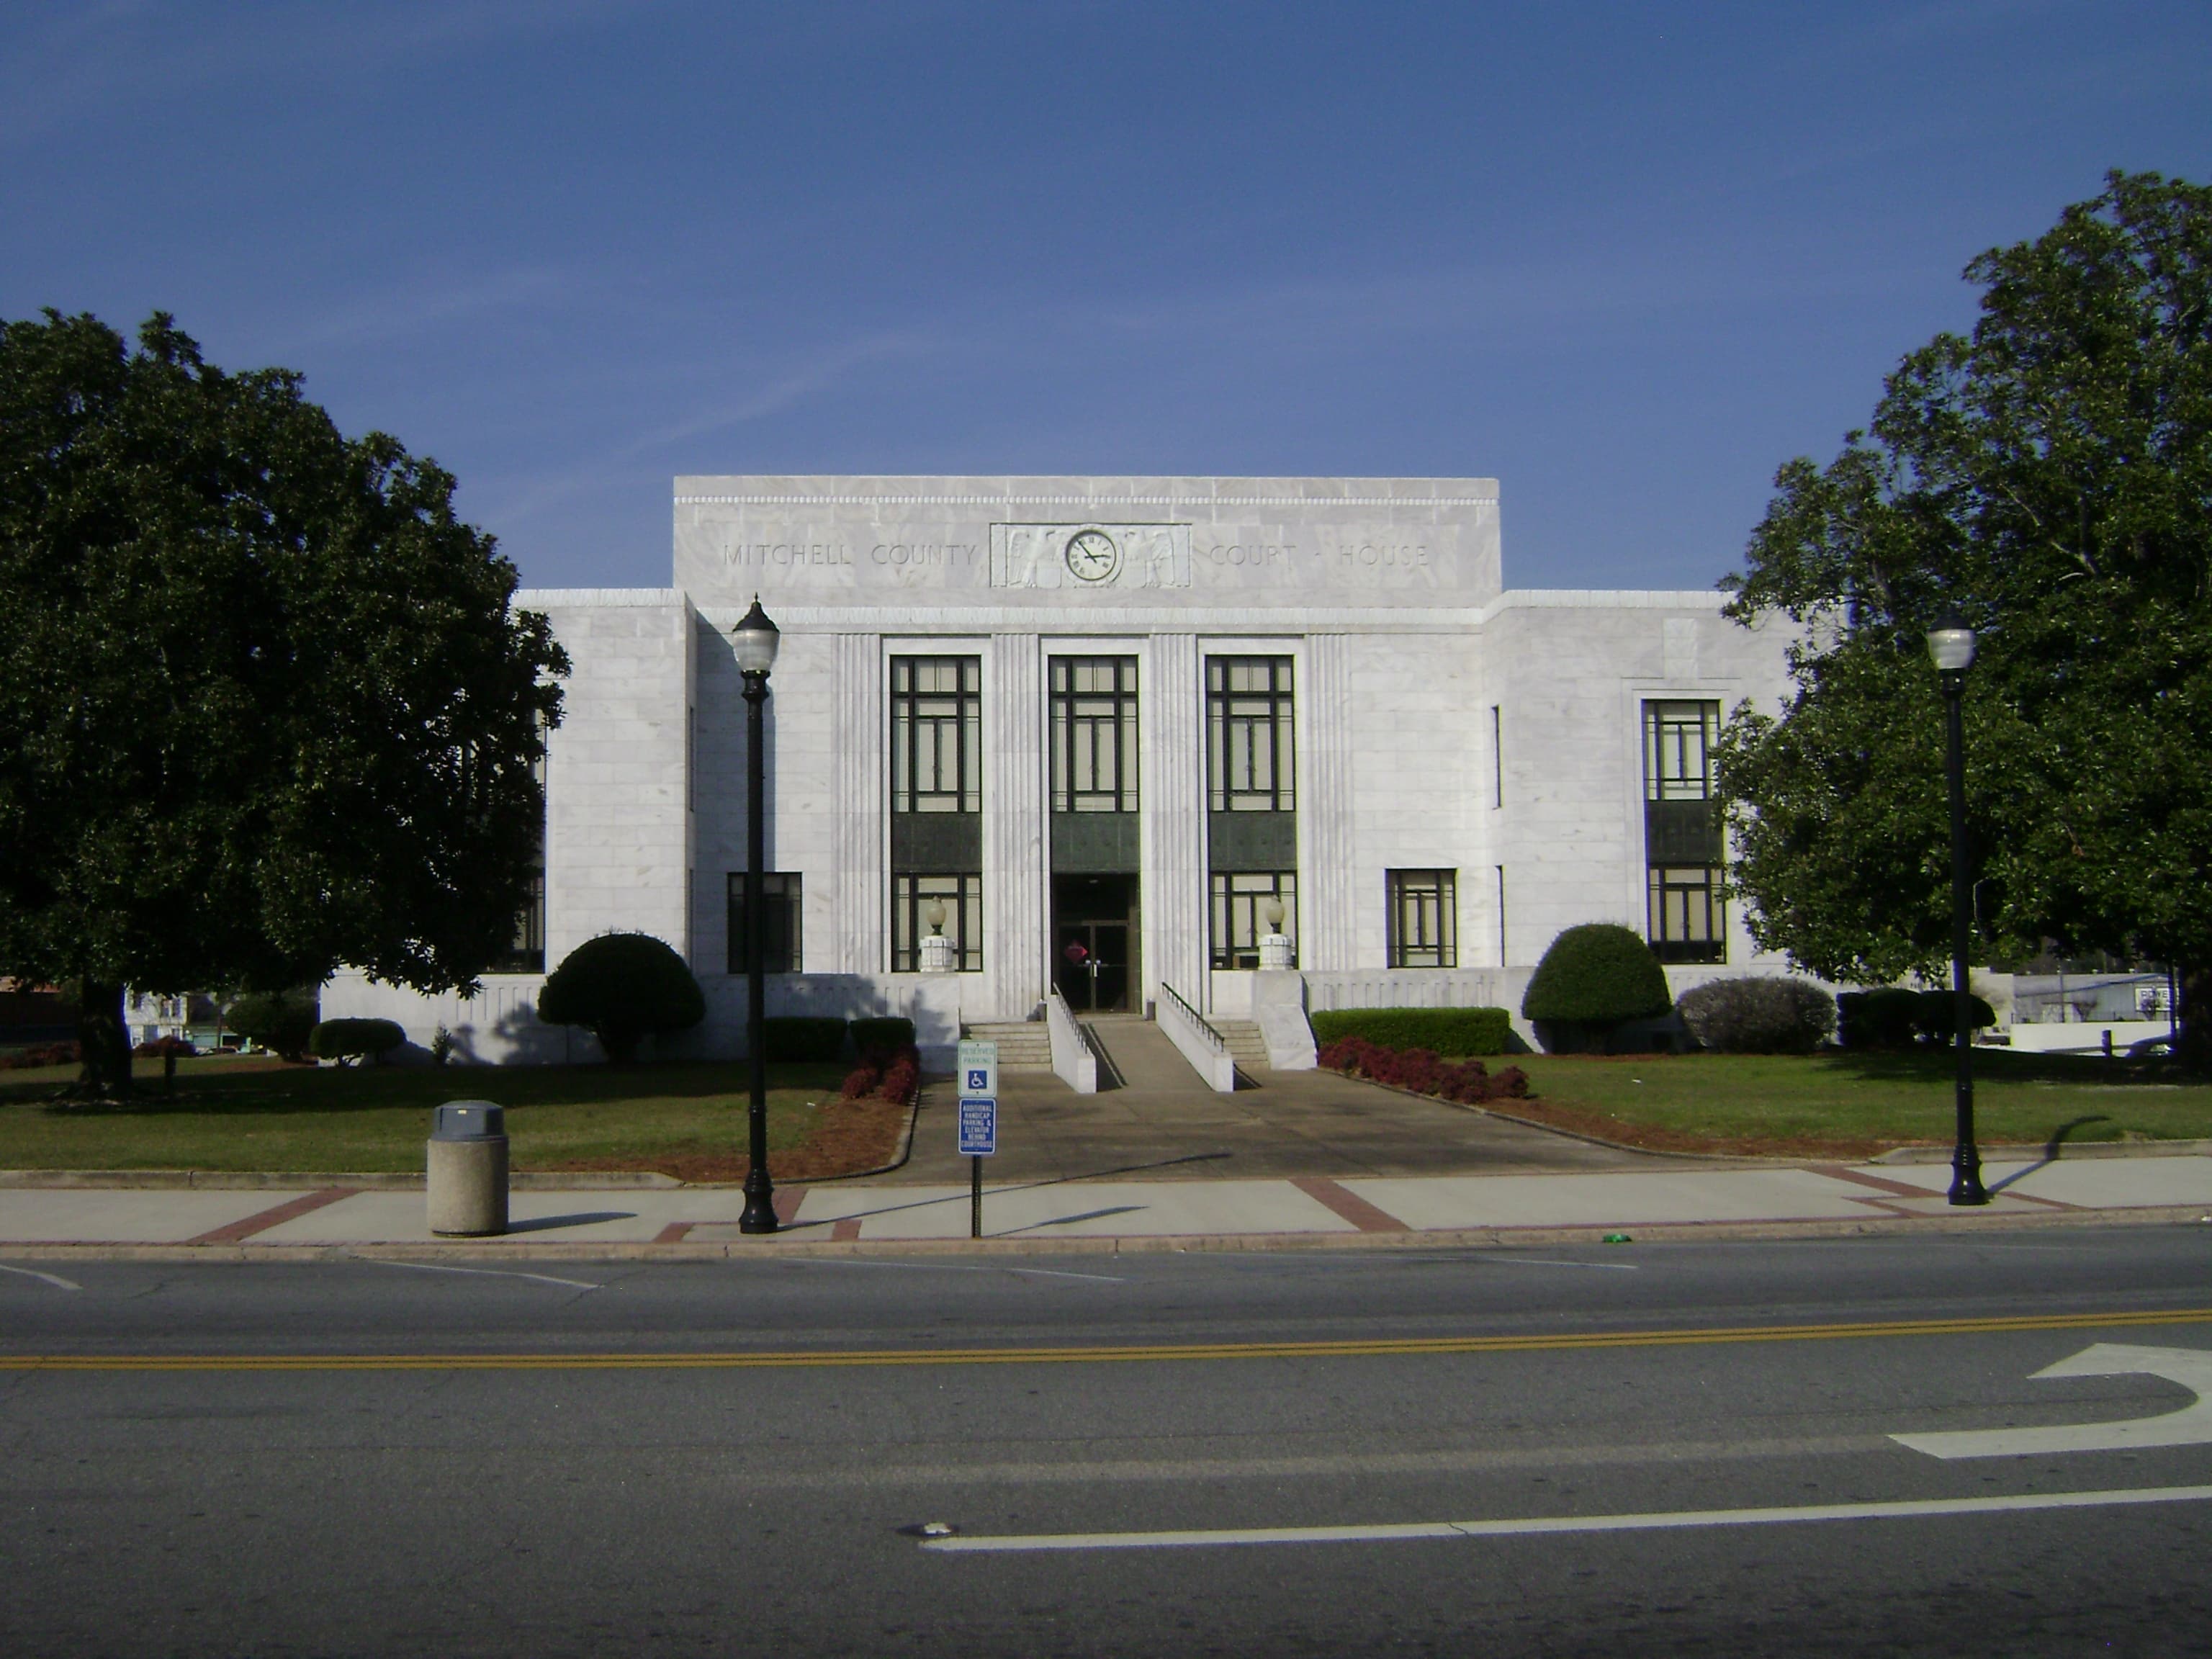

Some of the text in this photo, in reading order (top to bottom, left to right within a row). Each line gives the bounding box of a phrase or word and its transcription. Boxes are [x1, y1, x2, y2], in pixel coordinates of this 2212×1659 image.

[724, 544, 852, 565] MITCHELL
[871, 544, 979, 565] COUNTY
[1210, 544, 1297, 566] COURT
[1338, 544, 1429, 566] HOUSE
